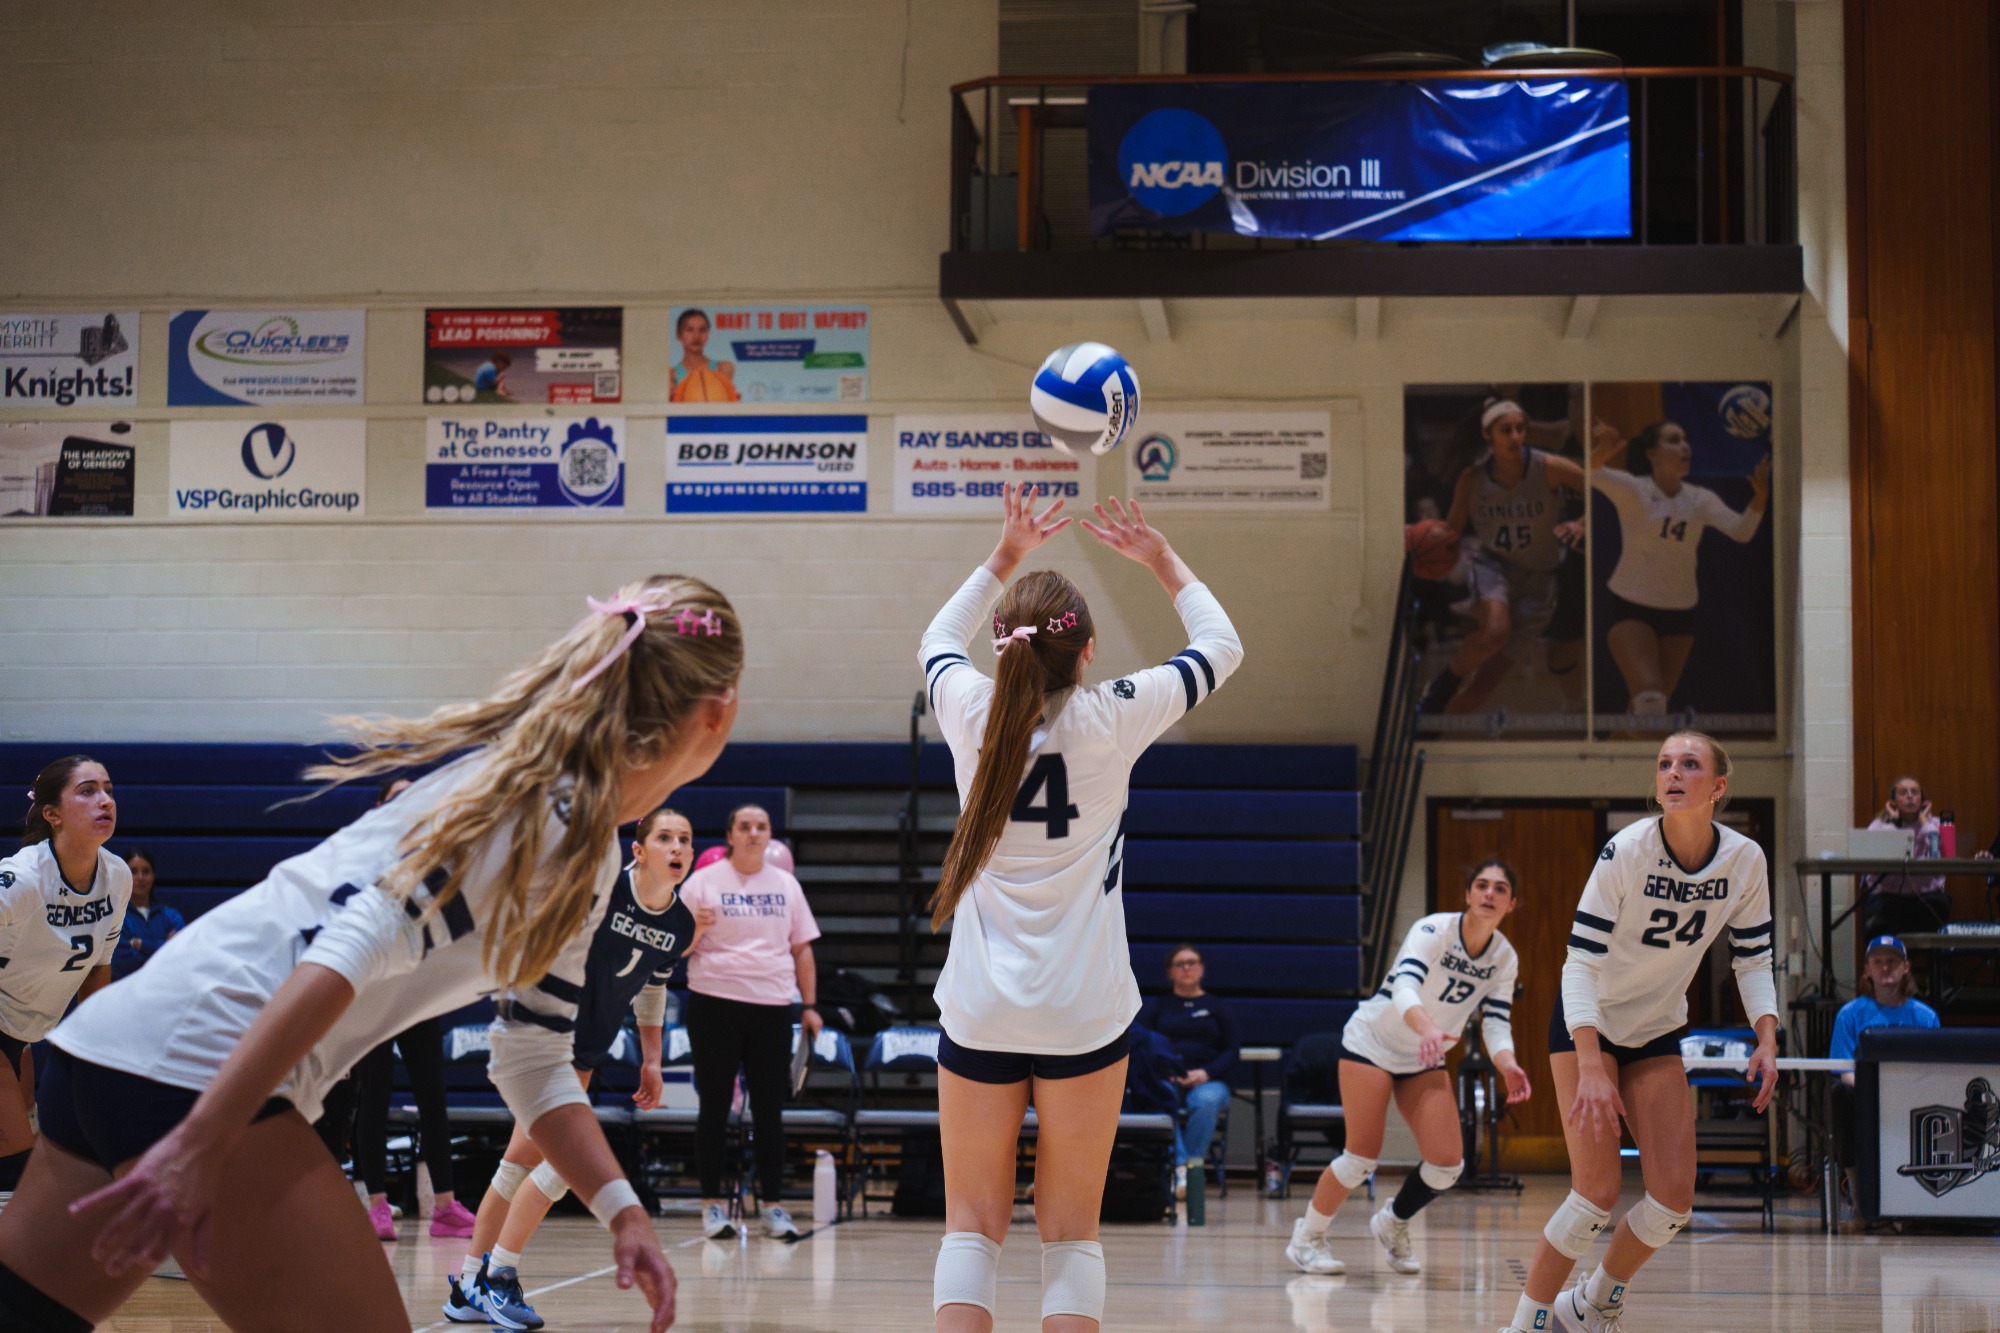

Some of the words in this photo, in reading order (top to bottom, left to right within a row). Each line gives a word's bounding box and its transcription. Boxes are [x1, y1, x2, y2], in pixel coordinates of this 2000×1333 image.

[1130, 161, 1224, 189] NCAA
[1236, 160, 1350, 188] Division
[1361, 159, 1380, 187] III
[715, 312, 751, 330] WANT
[757, 312, 773, 330] TO
[778, 312, 808, 330] QUIT
[813, 311, 868, 329] VAPING?
[0, 334, 54, 348] ERRITT
[438, 328, 473, 342] LEAD
[476, 328, 551, 341] POISONING?
[5, 366, 133, 405] Knights!
[442, 421, 478, 440] The
[485, 421, 551, 443] Pantry
[900, 432, 941, 448] RAY
[945, 431, 1019, 448] SANDS
[63, 450, 80, 460] THE
[82, 450, 131, 460] MEADOWS
[438, 442, 457, 458] at
[463, 441, 553, 458] Geneseo
[678, 443, 729, 460] BOB
[735, 443, 857, 465] JOHNSON
[67, 460, 81, 469] OF
[83, 460, 126, 469] GENESEO
[460, 466, 470, 477] A
[472, 466, 499, 477] Free
[501, 466, 532, 477] Food
[817, 463, 855, 472] USED
[912, 458, 949, 471] Auto
[959, 458, 1001, 471] Home
[1013, 458, 1080, 471] Business
[451, 479, 504, 490] Resource
[506, 478, 540, 492] Open
[673, 484, 861, 498] BOBJOHNSONUSED.COM
[452, 493, 465, 504] to
[468, 493, 484, 504] All
[486, 493, 538, 504] Students
[1659, 516, 1688, 541] 14
[1494, 525, 1532, 551] 45
[1009, 752, 1080, 840] 4
[1643, 874, 1729, 903] GENESEO
[721, 893, 786, 906] GENESEO
[722, 907, 786, 918] VOLLEYBALL
[610, 912, 676, 953] GENESEO
[1641, 909, 1707, 949] 24
[59, 934, 94, 973] 2
[1439, 977, 1476, 1004] 13
